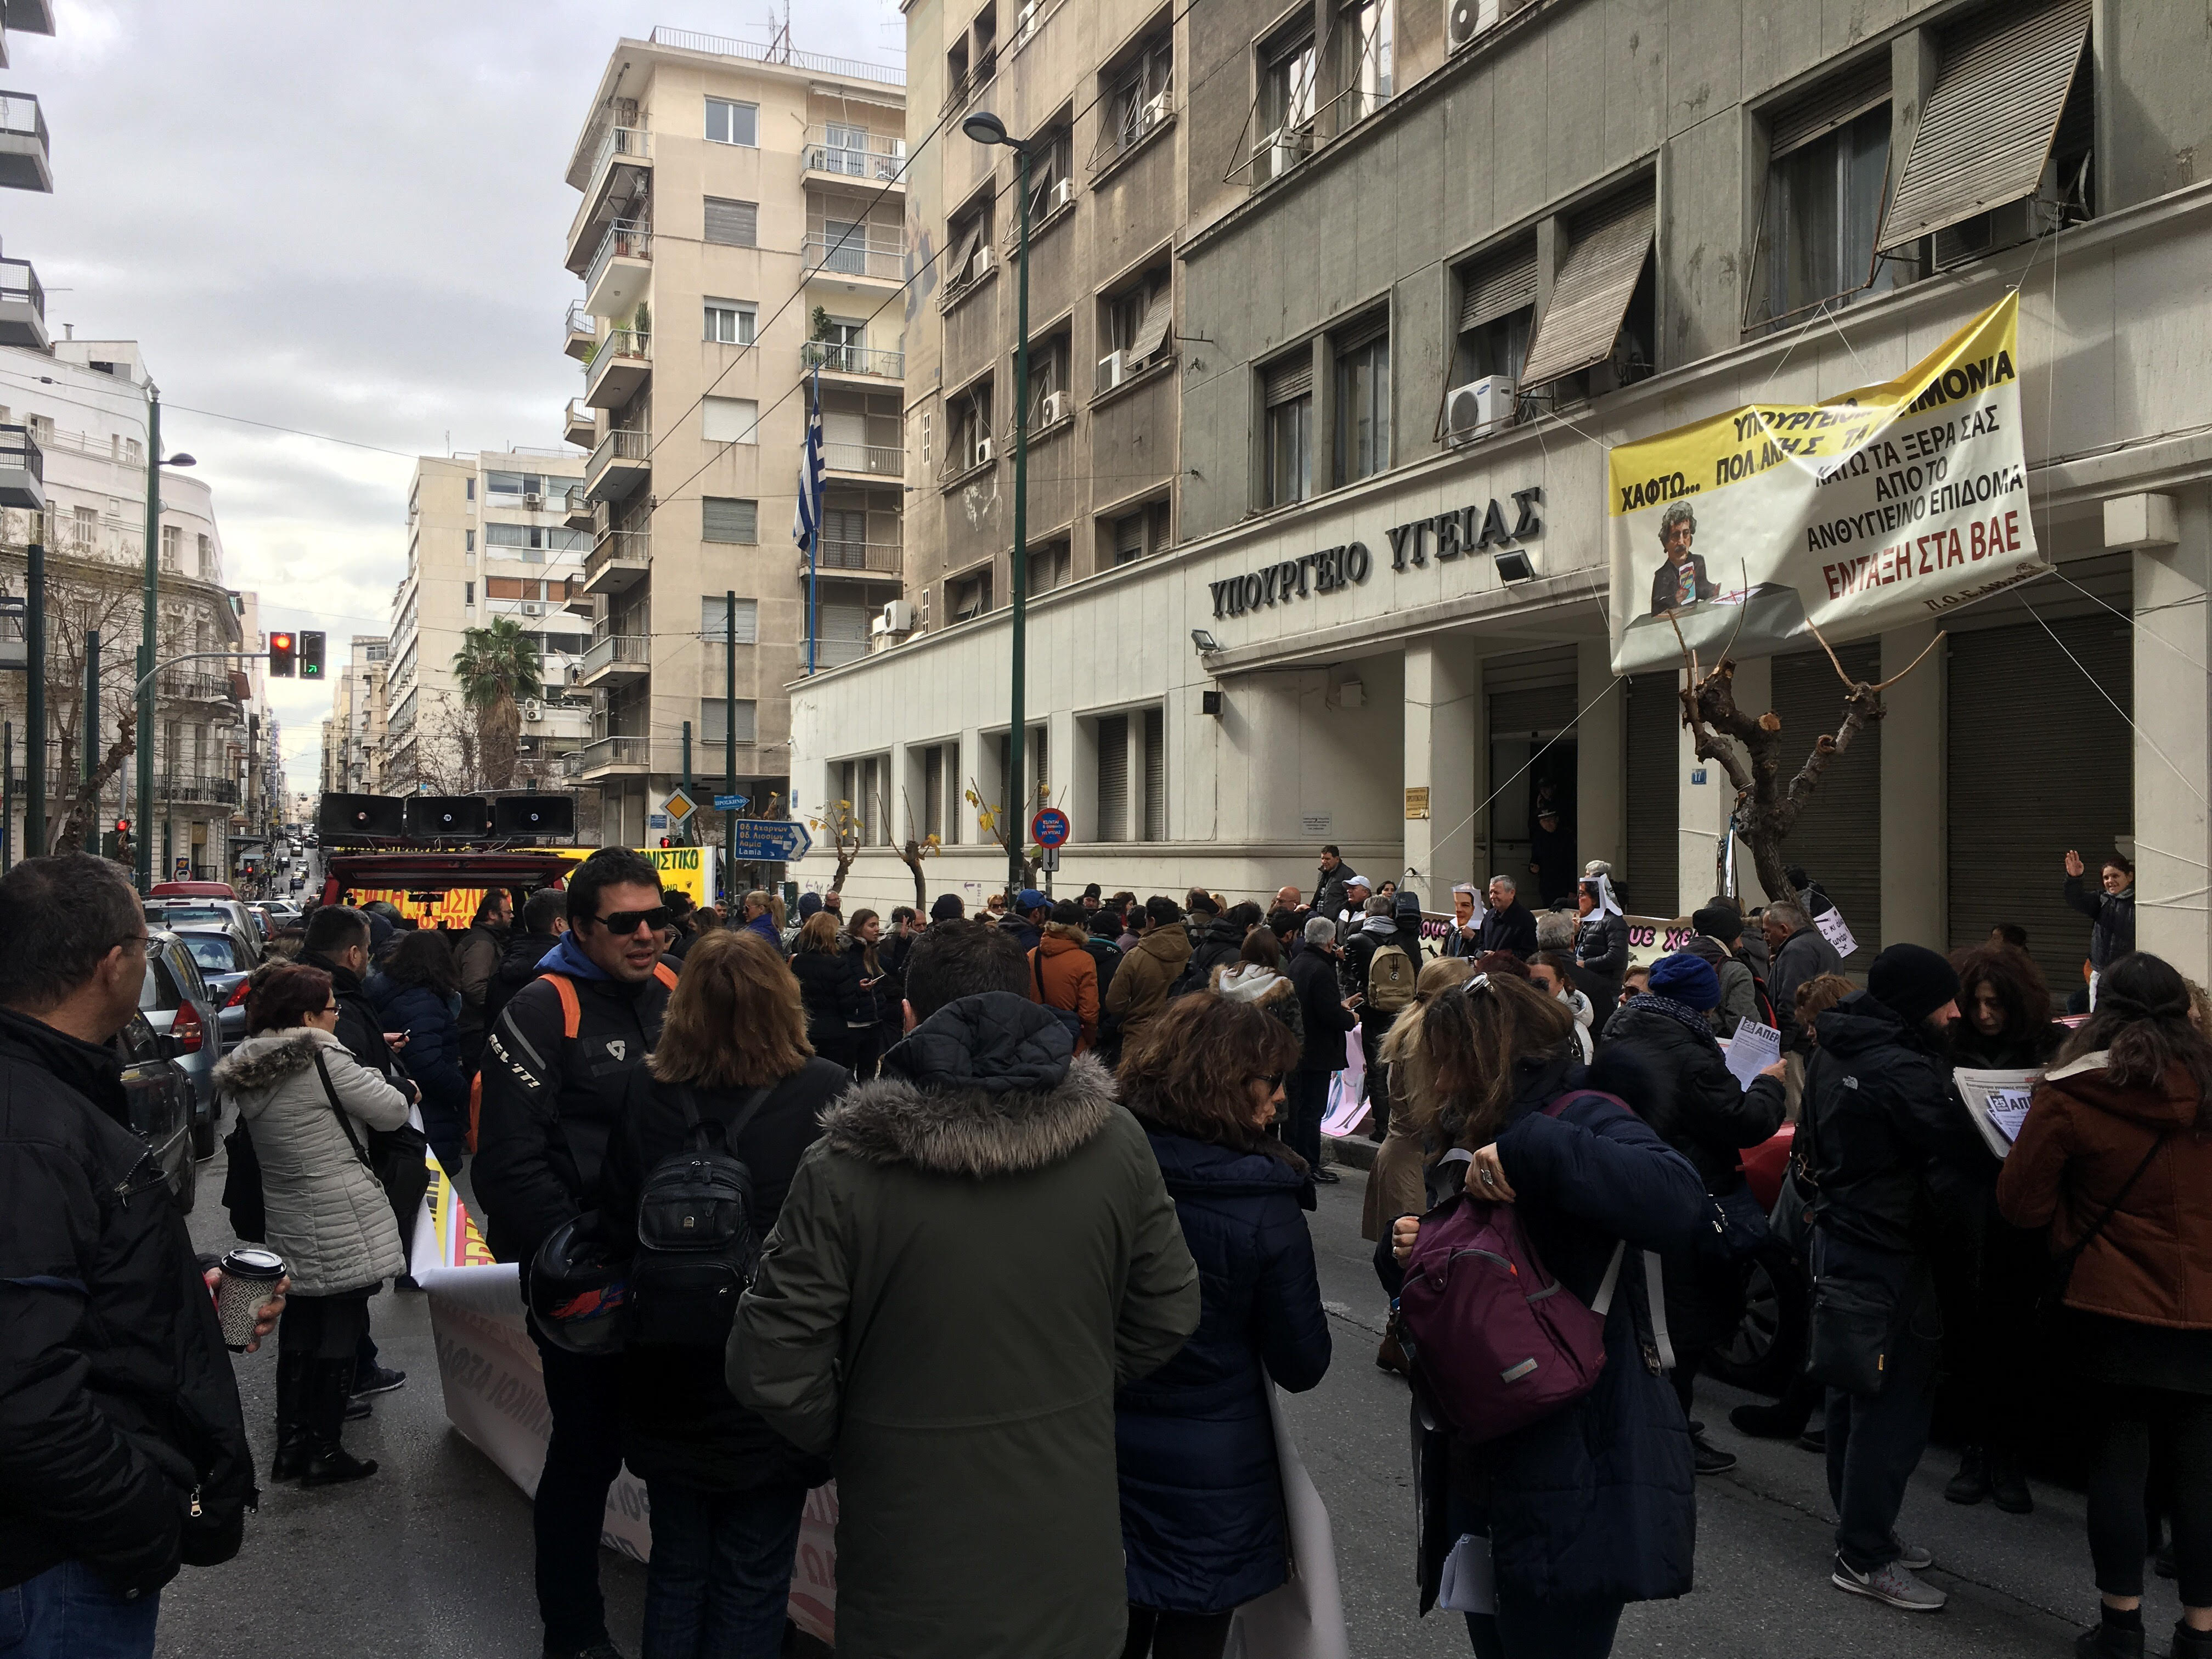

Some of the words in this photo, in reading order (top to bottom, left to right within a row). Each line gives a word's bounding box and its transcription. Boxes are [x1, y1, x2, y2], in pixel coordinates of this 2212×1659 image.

[1842, 424, 1870, 450] ΤΑ
[1869, 441, 1901, 469] ΤΑ
[1901, 421, 1956, 461] ΞΕΡΑ
[1960, 405, 2000, 442] ΣΑΣ
[1876, 466, 1923, 501] ΑΠΟ
[1926, 456, 1948, 485] ΤΟ
[1808, 495, 1925, 552] ΑΝΘΥΓΙΕΙΝΟ
[1931, 464, 2024, 516] ΕΠΙΔΟΜΑ
[1209, 541, 1368, 617] ΥΠΟΥΡΓΕΙΟ
[1385, 487, 1540, 570] ΥΓΕΙΑΣ
[1822, 541, 1912, 600] ΕΝΤΑΞΗ
[1917, 528, 1964, 575] ΣΤΑ
[1971, 510, 2021, 561] ΒΑΕ
[1695, 772, 1701, 781] 17
[1745, 1020, 1755, 1029] 25
[1754, 1026, 1779, 1042] ΑΠΕΡ
[1993, 1098, 2006, 1107] 25
